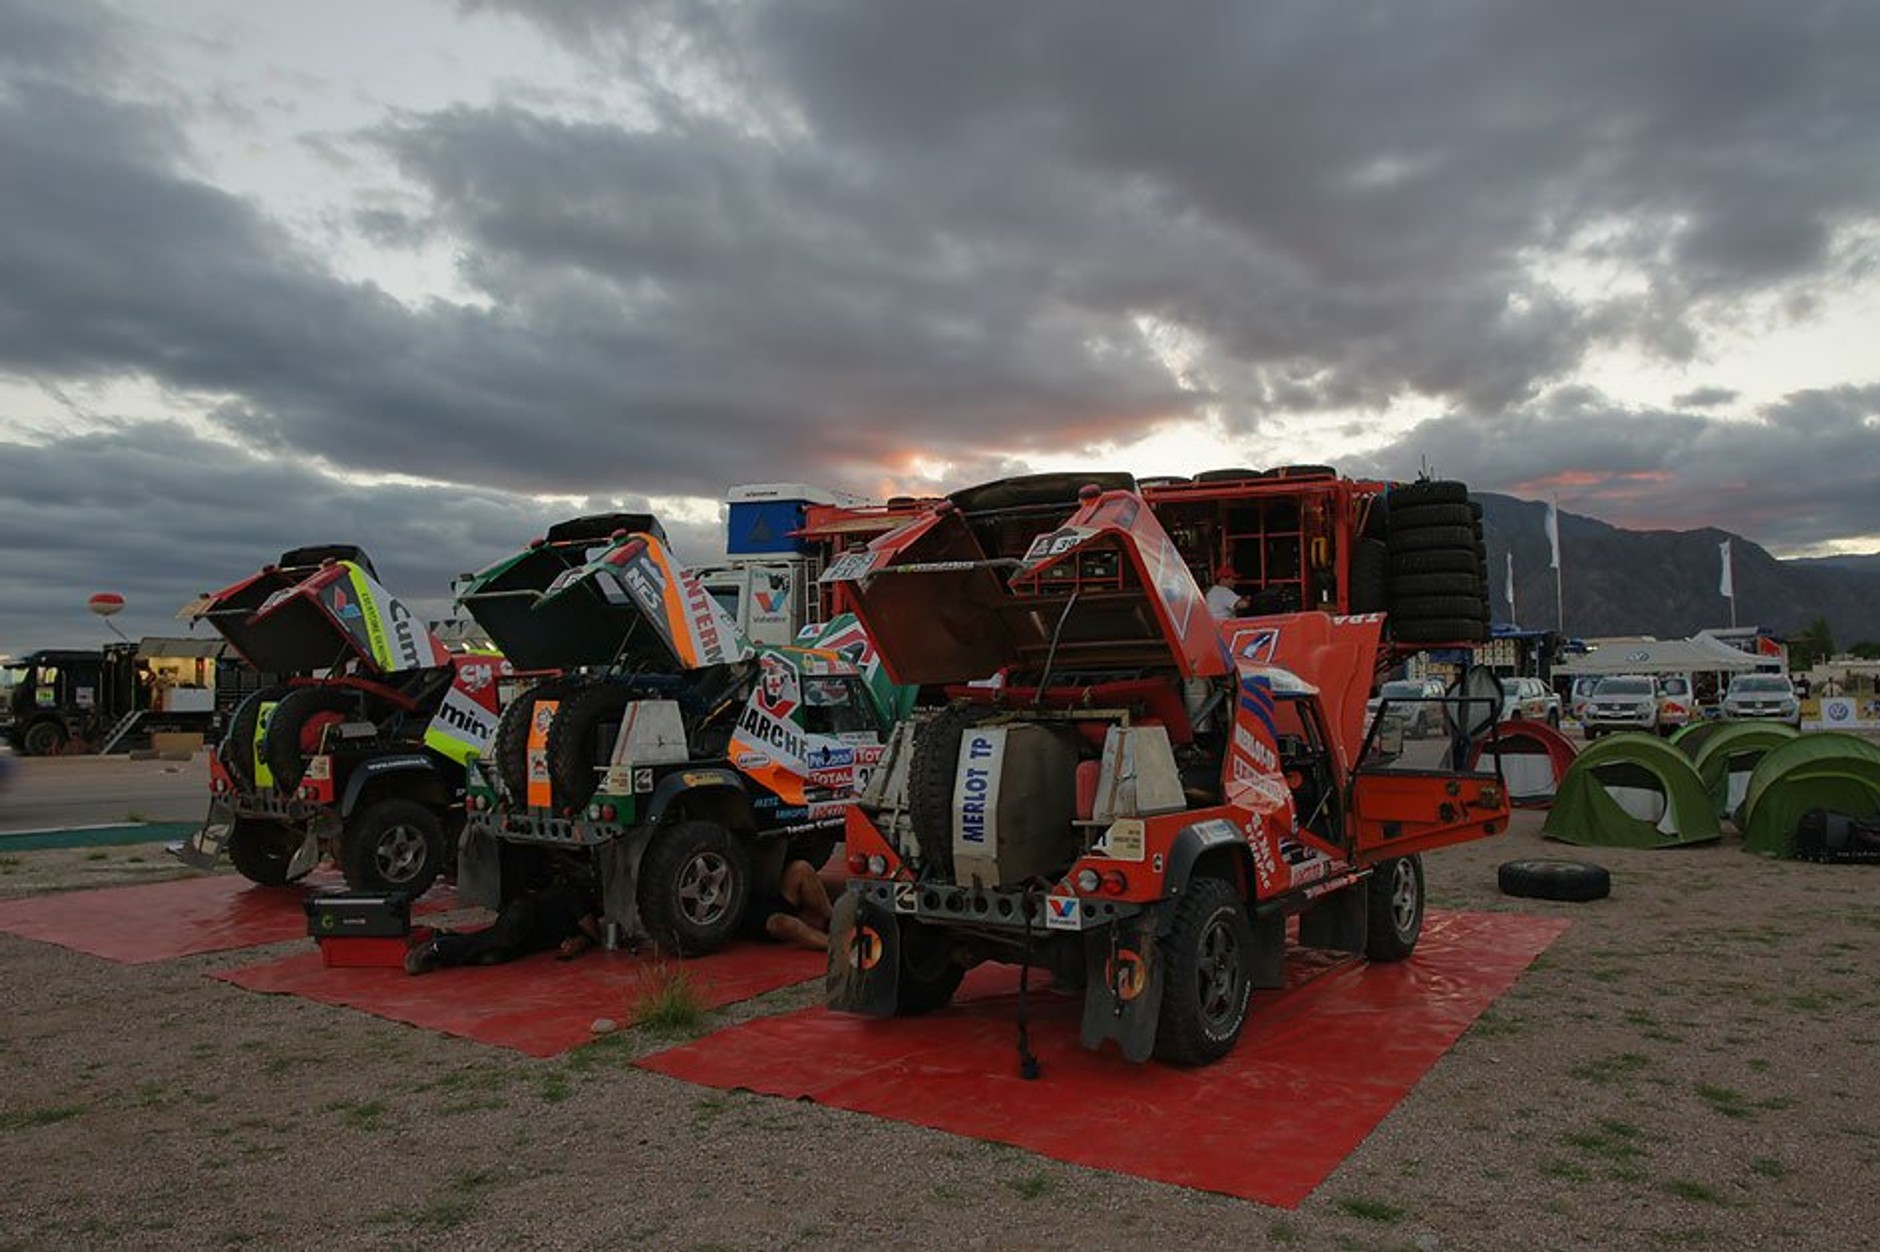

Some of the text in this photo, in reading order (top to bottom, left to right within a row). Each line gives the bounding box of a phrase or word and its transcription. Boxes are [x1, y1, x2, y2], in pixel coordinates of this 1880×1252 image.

[811, 773, 852, 785] TOTAL
[963, 738, 992, 843] MERLOT TP
